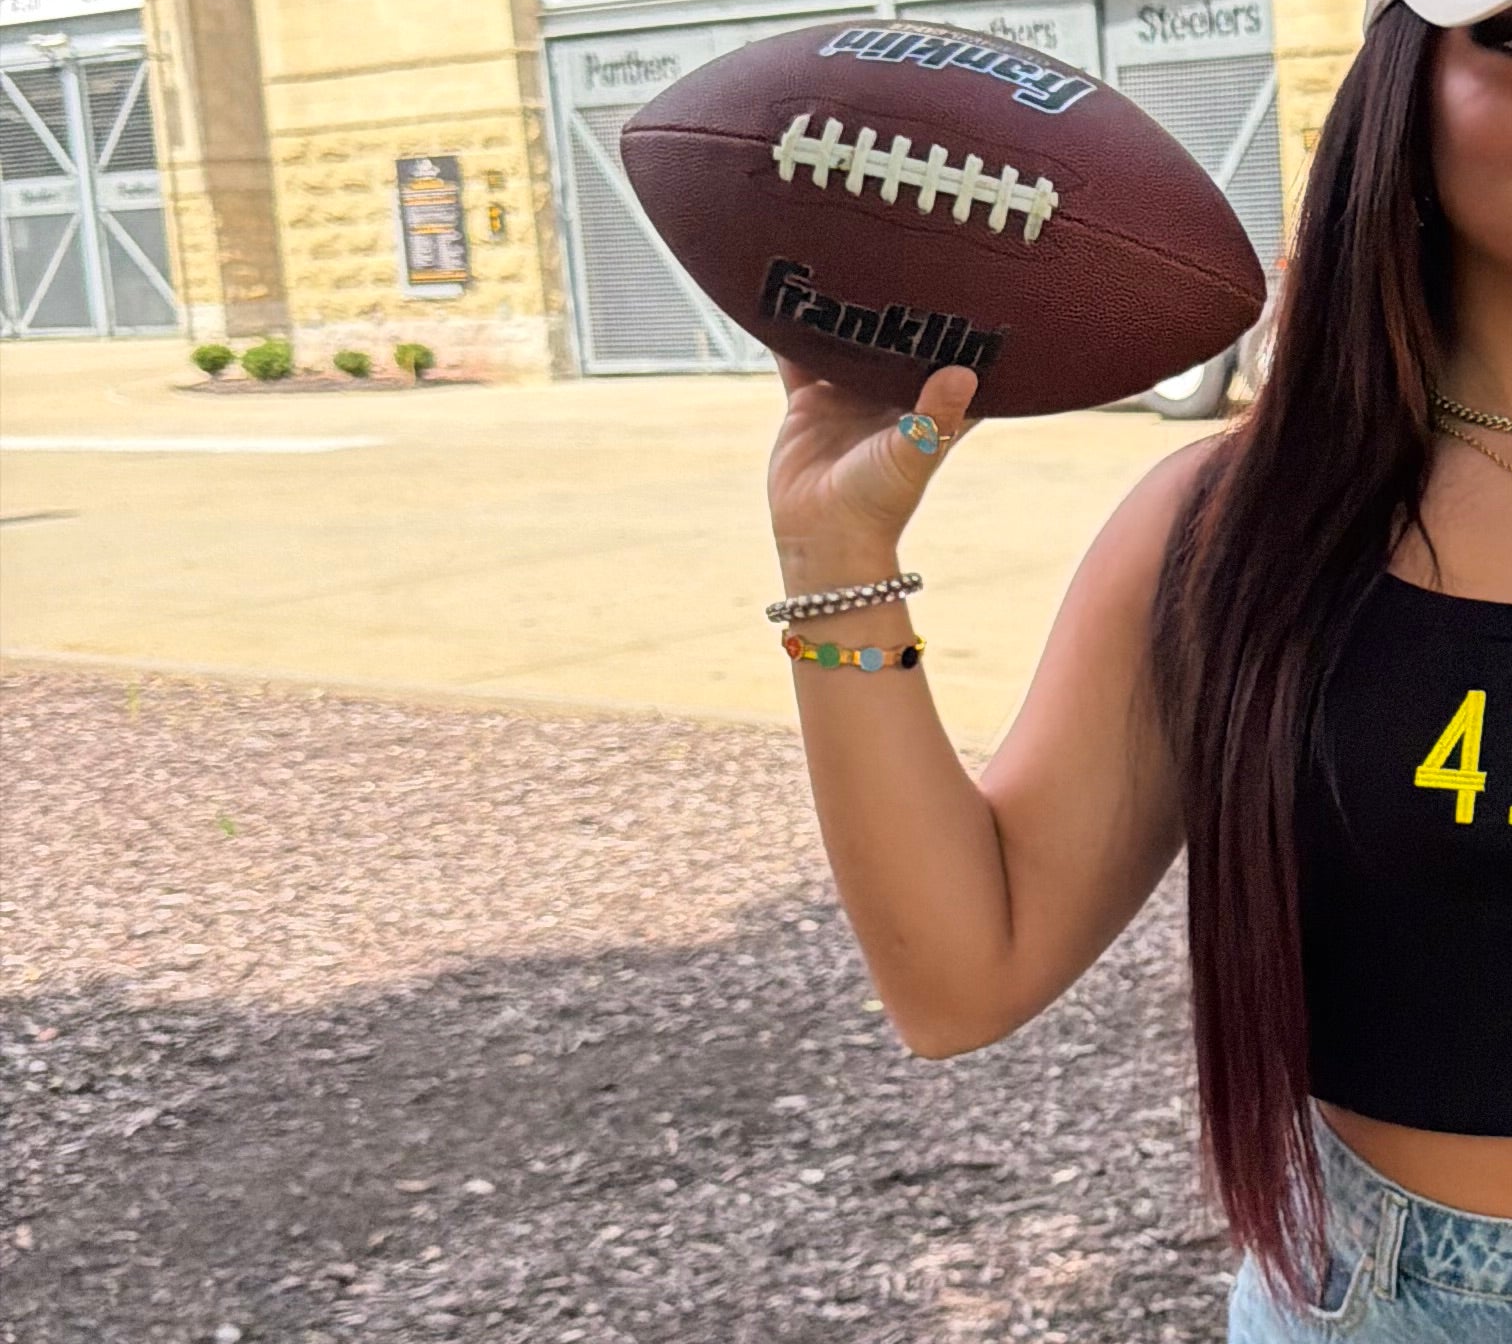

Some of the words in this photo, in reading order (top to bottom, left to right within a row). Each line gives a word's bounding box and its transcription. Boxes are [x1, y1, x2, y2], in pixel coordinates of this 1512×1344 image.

[584, 50, 680, 90] Panthers
[820, 27, 1097, 114] Franklin
[760, 256, 1007, 368] Franklin
